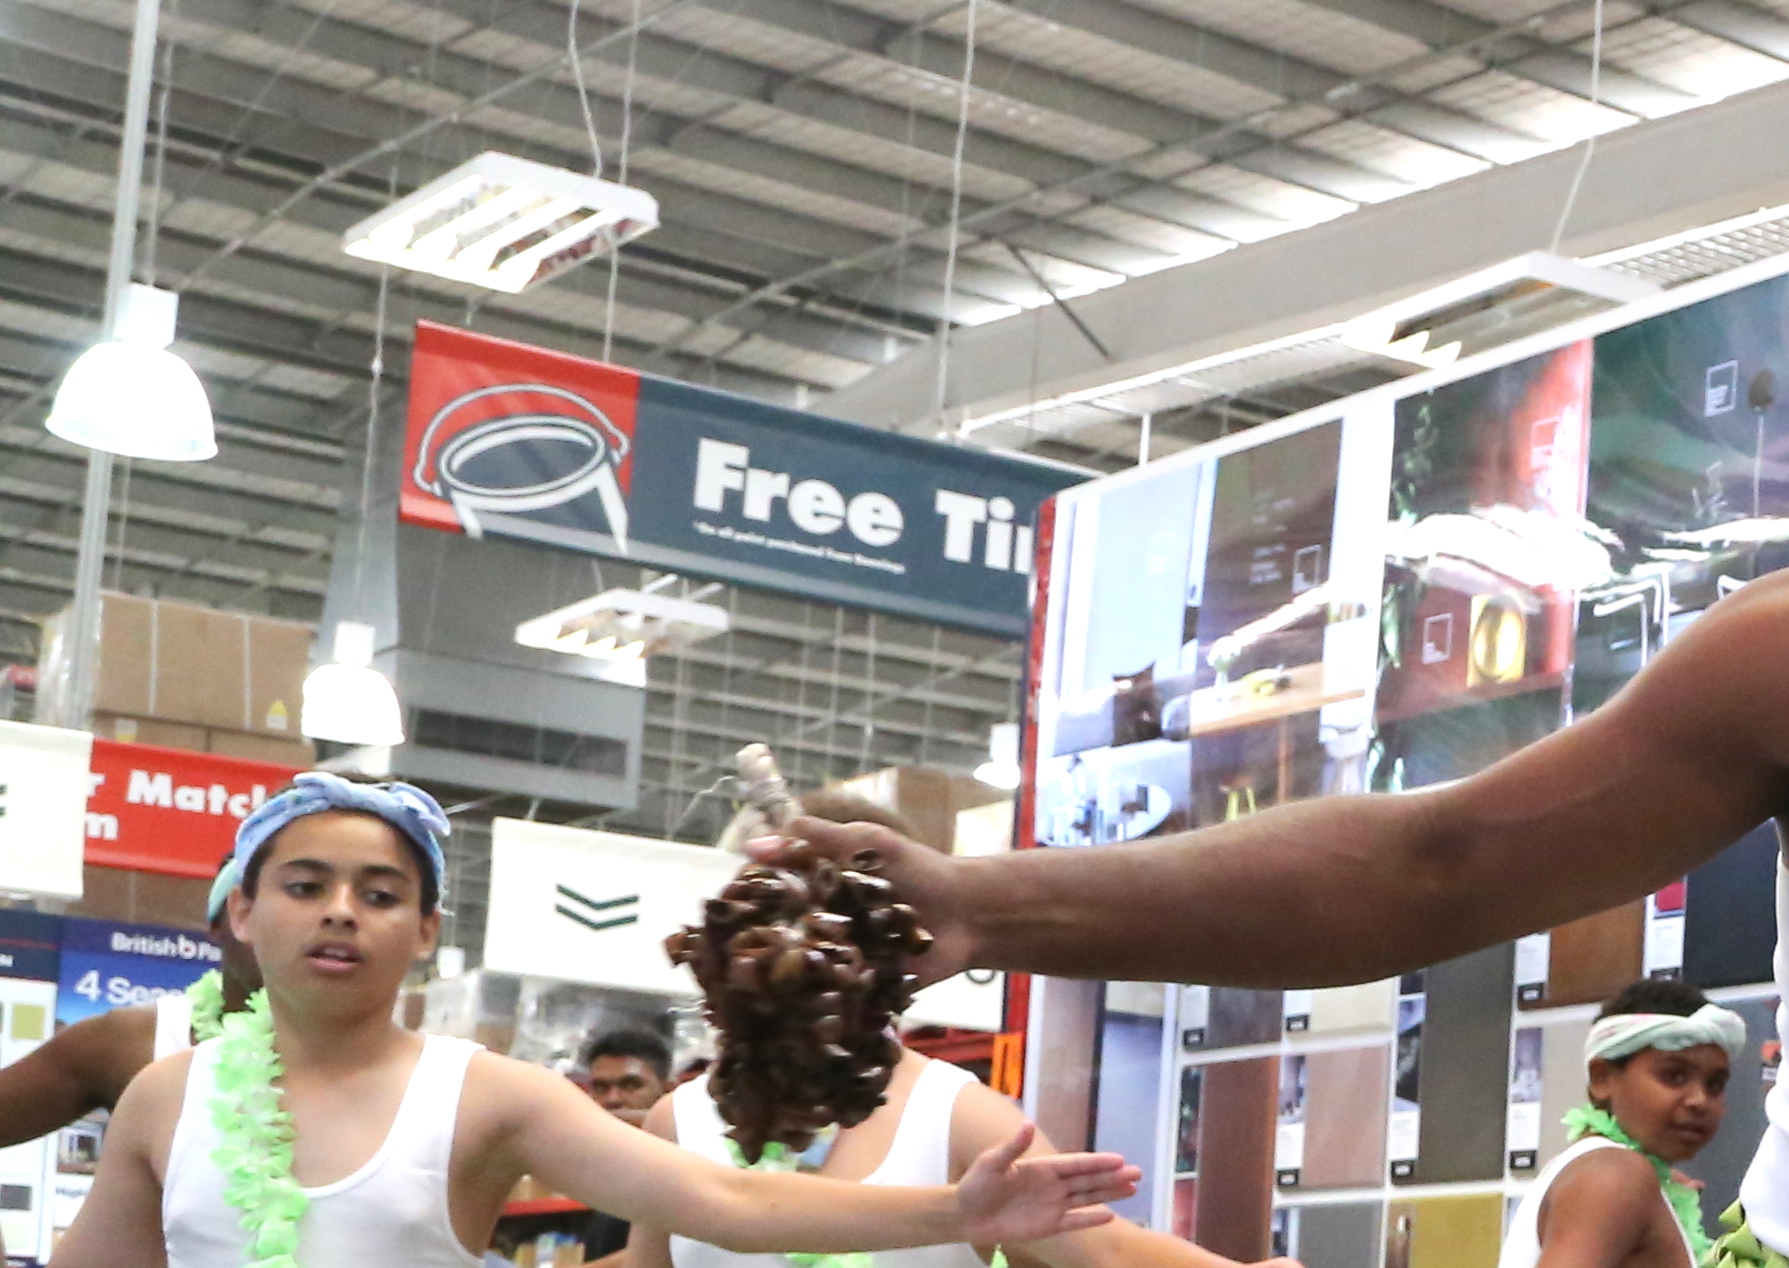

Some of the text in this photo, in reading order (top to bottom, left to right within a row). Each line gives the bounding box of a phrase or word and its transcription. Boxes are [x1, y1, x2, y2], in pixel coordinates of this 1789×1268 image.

[694, 436, 902, 546] Free
[111, 933, 175, 956] British
[75, 970, 101, 1000] 4
